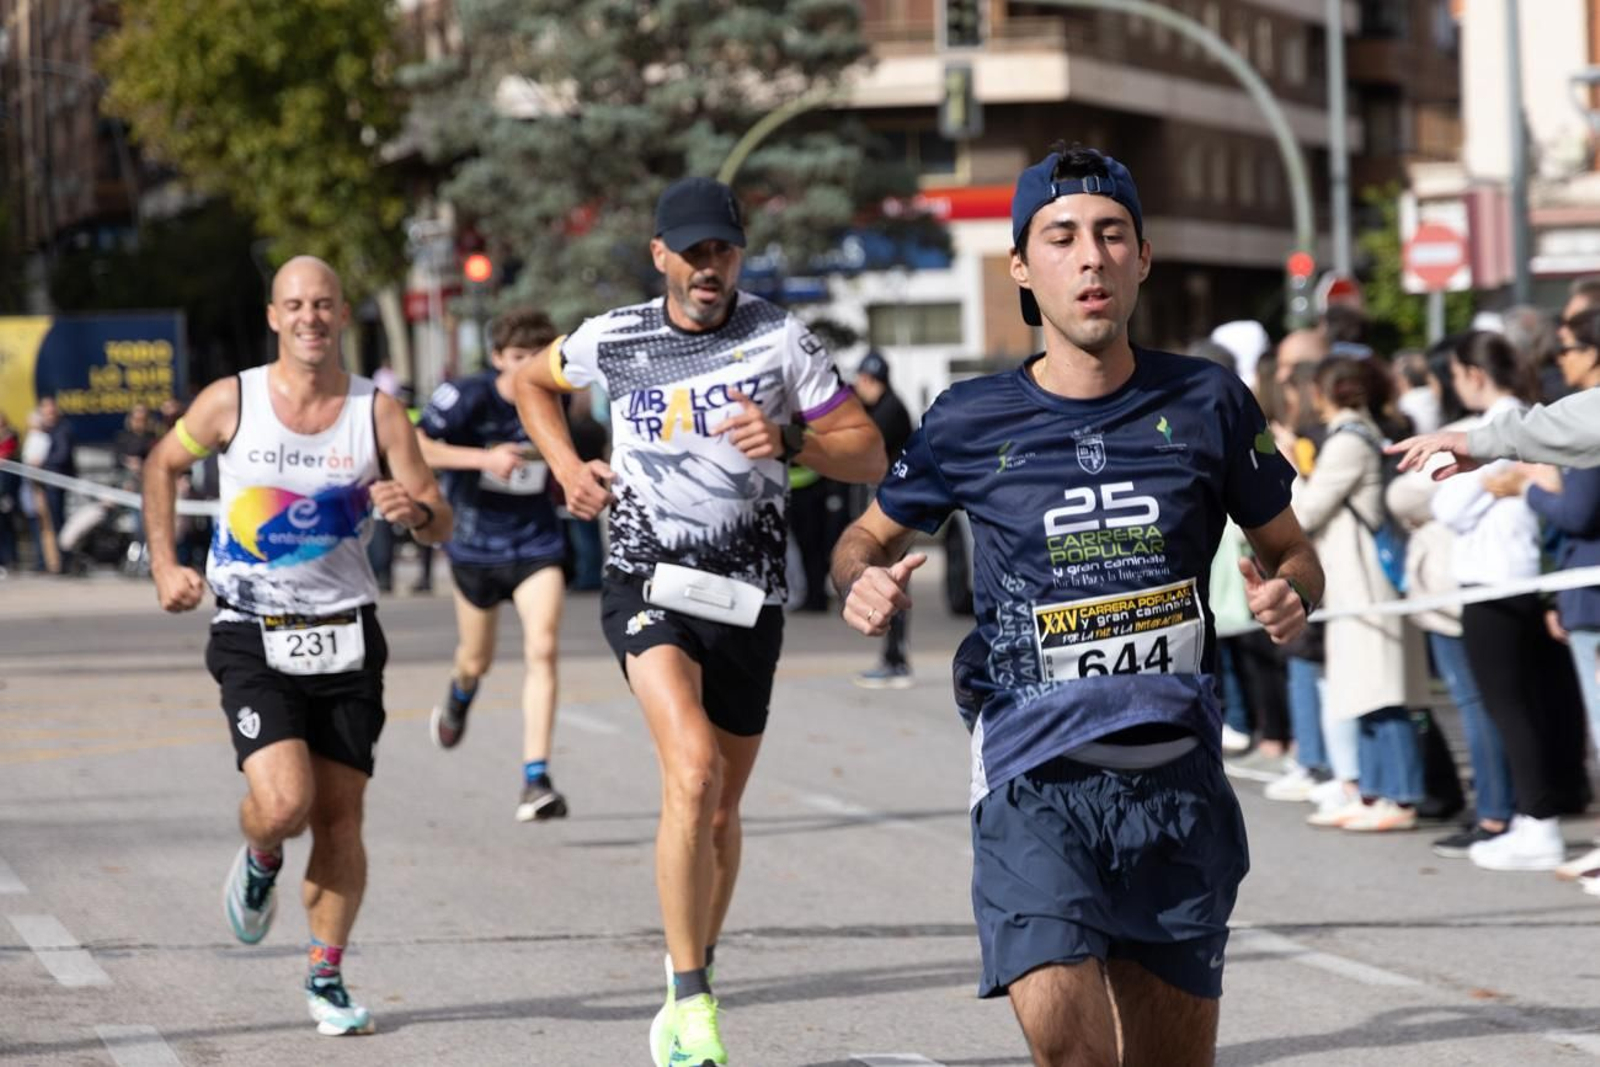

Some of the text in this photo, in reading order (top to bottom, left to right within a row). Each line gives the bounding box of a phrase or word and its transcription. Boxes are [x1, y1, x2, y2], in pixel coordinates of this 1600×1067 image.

[247, 442, 355, 473] calderón
[1043, 481, 1160, 537] 25
[1046, 525, 1163, 552] CARRERA
[1050, 540, 1165, 566] POPULAR
[1052, 567, 1064, 578] y
[1066, 561, 1100, 576] gran
[1080, 587, 1192, 619] CARRERA POPULAR
[1042, 609, 1078, 635] XXV
[1097, 611, 1129, 628] gran
[287, 630, 337, 657] 231
[1078, 635, 1173, 678] 644
